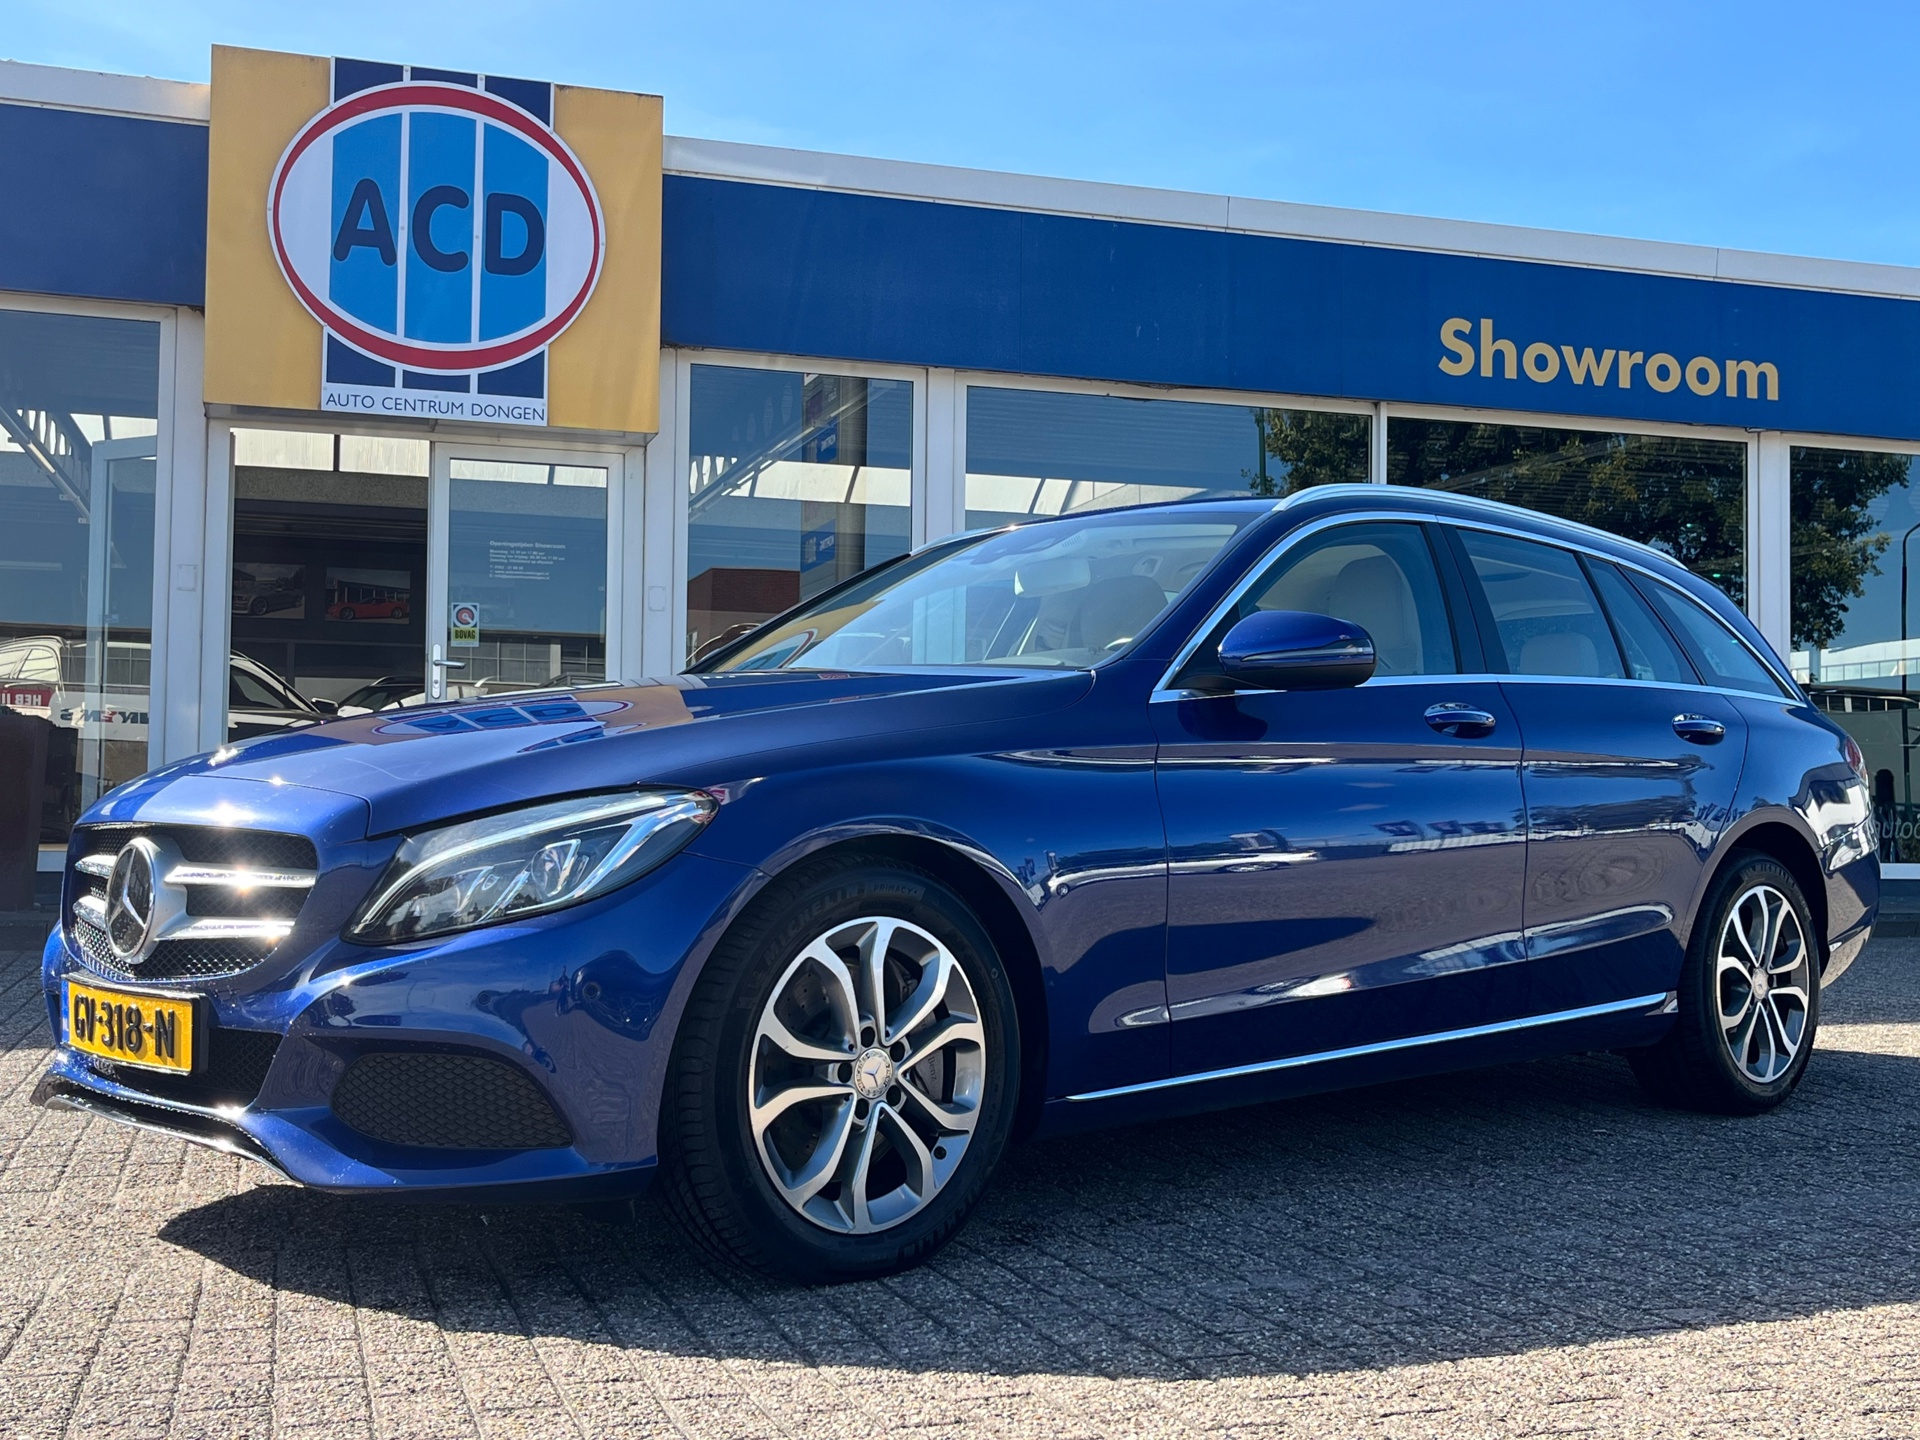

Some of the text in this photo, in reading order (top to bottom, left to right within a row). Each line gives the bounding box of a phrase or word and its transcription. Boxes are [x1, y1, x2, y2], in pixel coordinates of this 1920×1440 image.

[333, 178, 545, 276] ACD
[1438, 317, 1779, 401] Showroom
[325, 393, 545, 421] AUTO CENTRUM DONGEN
[455, 629, 476, 640] BOVAG
[873, 883, 913, 896] PRIMACY
[74, 993, 175, 1059] GV-318-N
